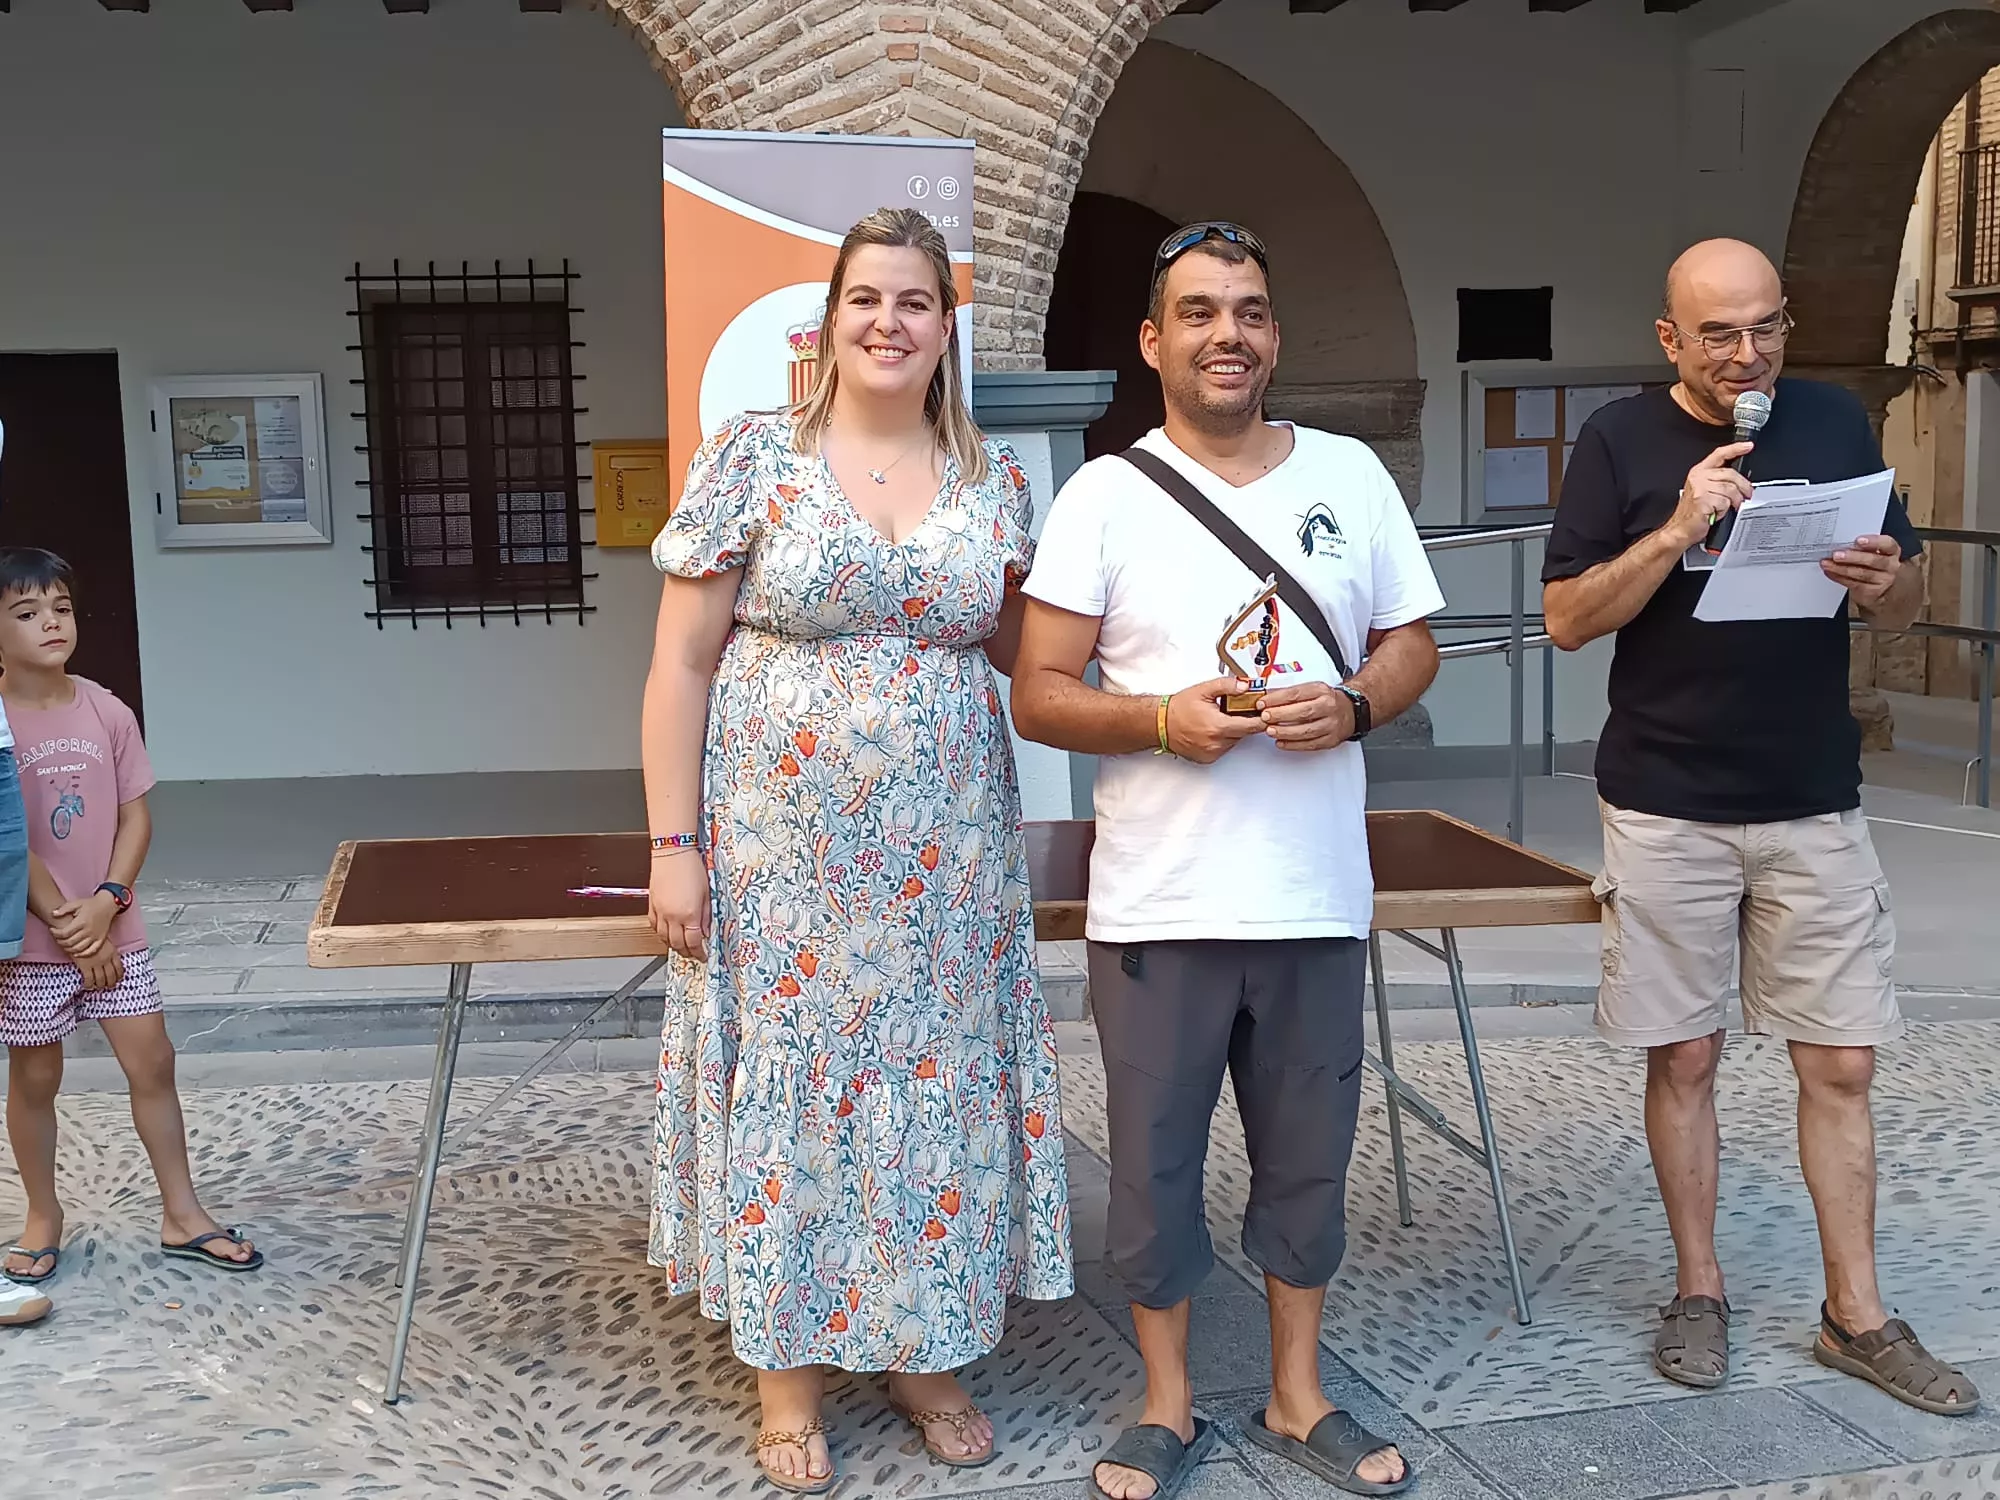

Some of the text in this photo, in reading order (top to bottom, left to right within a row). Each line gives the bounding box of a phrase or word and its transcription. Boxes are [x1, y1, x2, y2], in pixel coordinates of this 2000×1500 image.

[616, 470, 624, 511] CORREOS
[36, 762, 87, 776] SANTA MONICA
